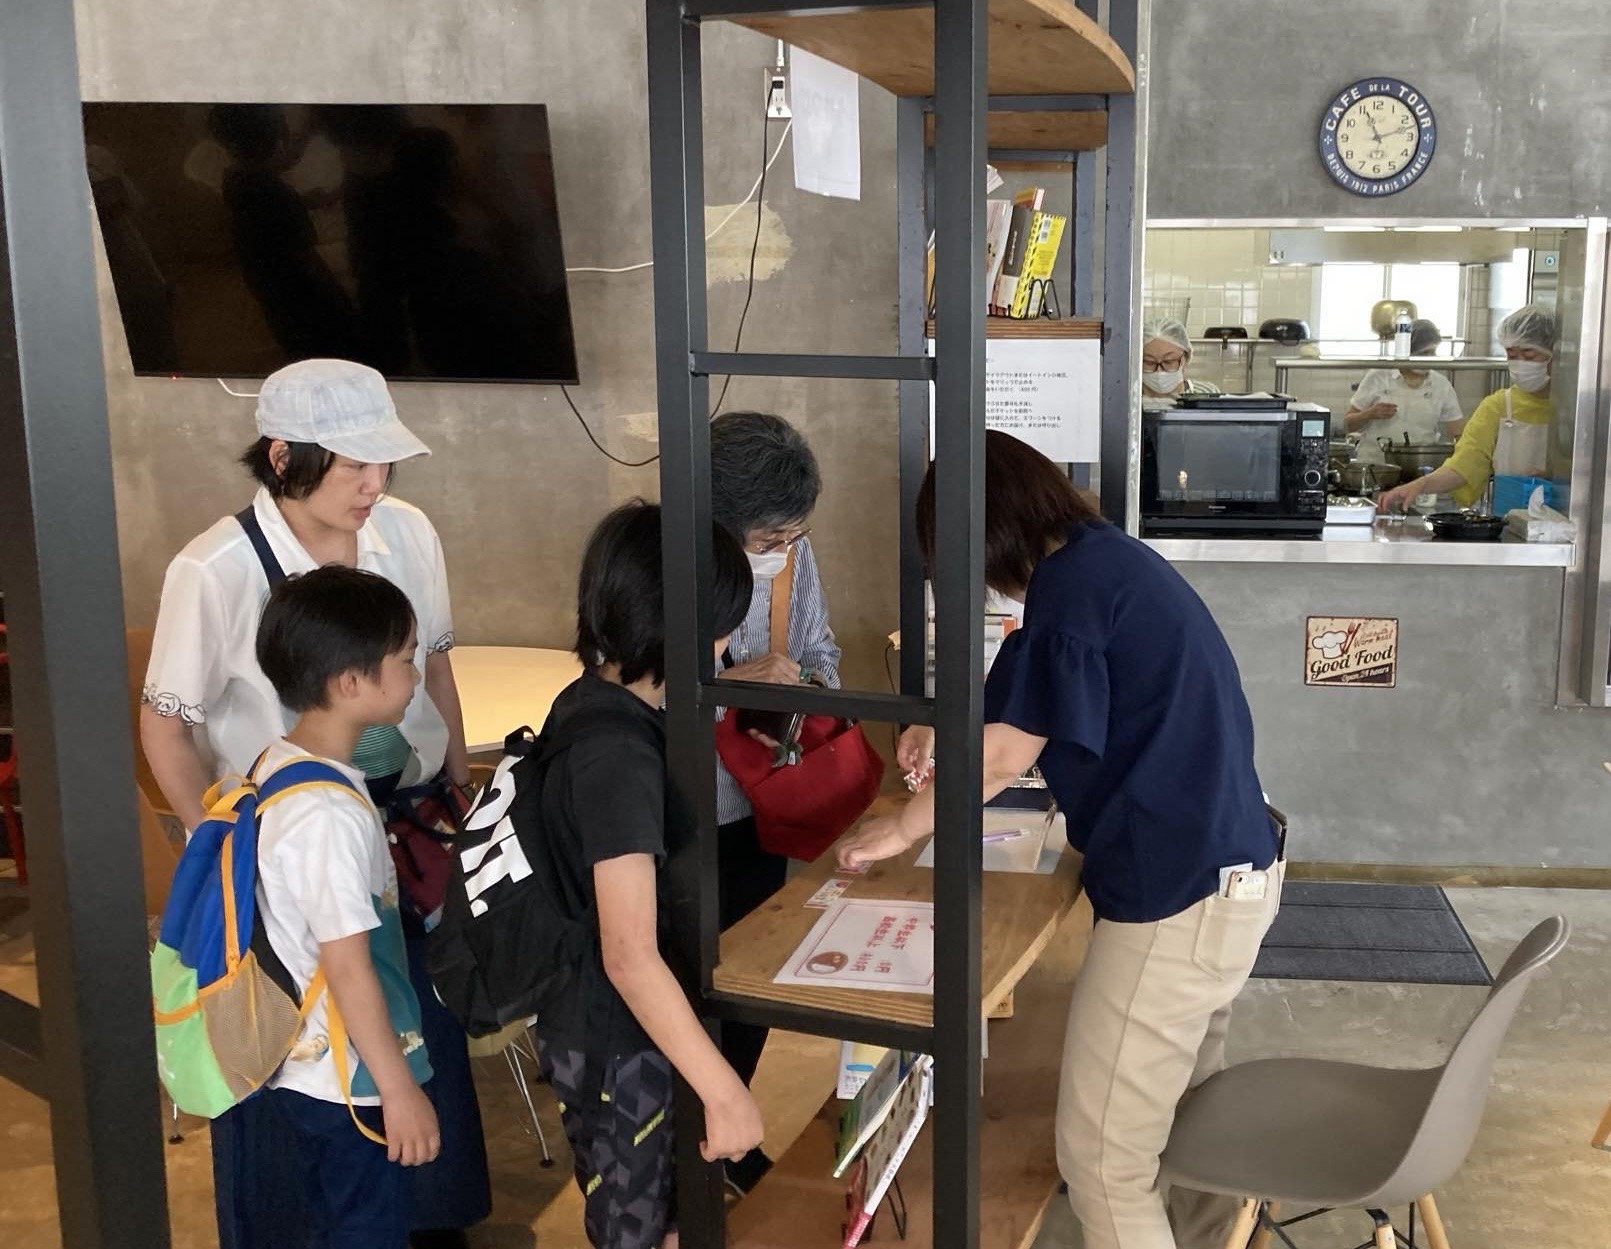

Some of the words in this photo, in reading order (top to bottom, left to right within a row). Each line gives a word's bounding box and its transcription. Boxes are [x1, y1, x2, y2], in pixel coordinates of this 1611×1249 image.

[1325, 87, 1362, 132] CAFE
[1368, 84, 1378, 92] DE
[1381, 83, 1390, 91] LA
[1399, 85, 1432, 128] TOUR
[1359, 105, 1366, 115] 11
[1373, 101, 1384, 110] 12
[1391, 105, 1395, 113] 1
[1346, 118, 1356, 128] 10
[1401, 116, 1409, 125] 2
[1341, 133, 1349, 143] 9
[1407, 132, 1414, 141] 3
[1345, 150, 1354, 159] 8
[1400, 149, 1408, 157] 4
[1358, 161, 1366, 170] 7
[1372, 165, 1381, 173] 6
[1388, 161, 1396, 170] 5
[1372, 180, 1399, 193] PARIS
[1402, 152, 1429, 184] FRANCE
[1310, 654, 1351, 680] Good
[1355, 644, 1393, 666] Food
